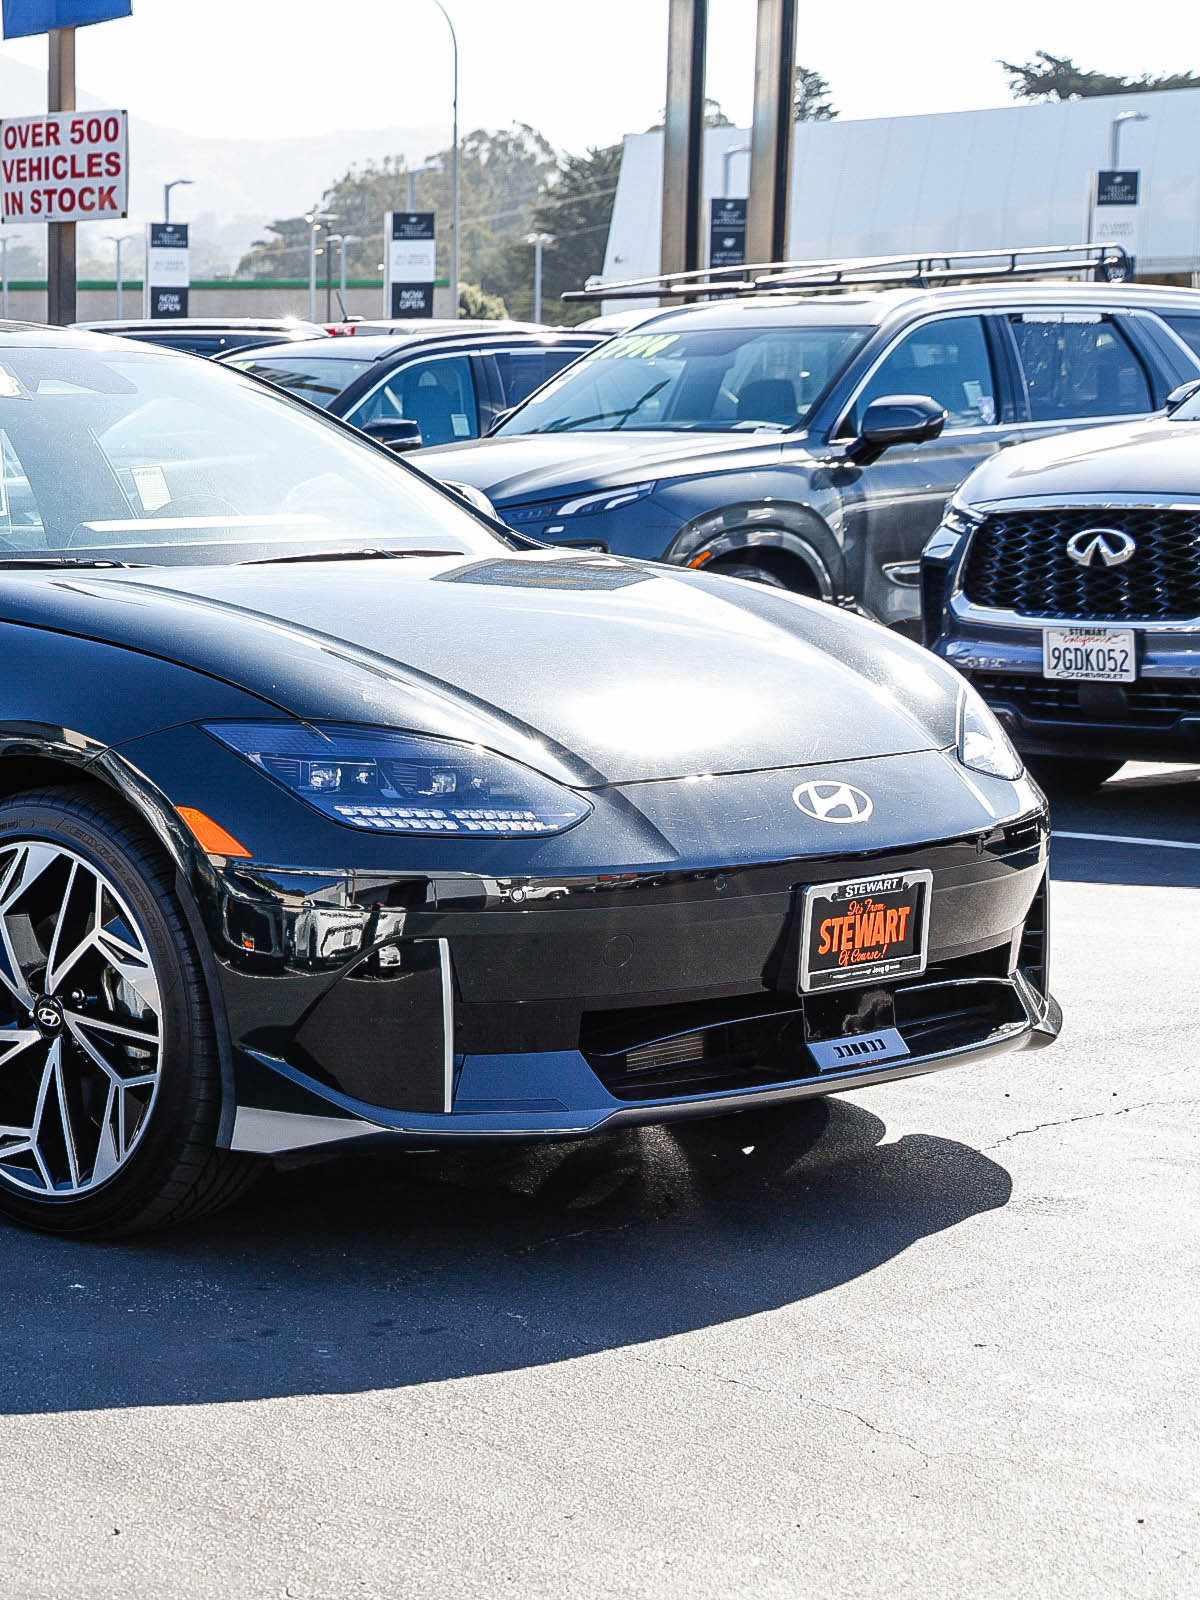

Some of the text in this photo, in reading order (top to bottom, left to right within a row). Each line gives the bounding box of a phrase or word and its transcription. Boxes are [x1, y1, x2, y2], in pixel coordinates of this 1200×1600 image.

[4, 117, 119, 150] OVER 500
[2, 152, 121, 183] VEHICLES
[4, 186, 118, 216] IN STOCK
[1069, 628, 1107, 636] STEWART
[1052, 648, 1130, 672] 9GDK052
[845, 879, 899, 897] STEWART
[818, 906, 910, 955] STEWART
